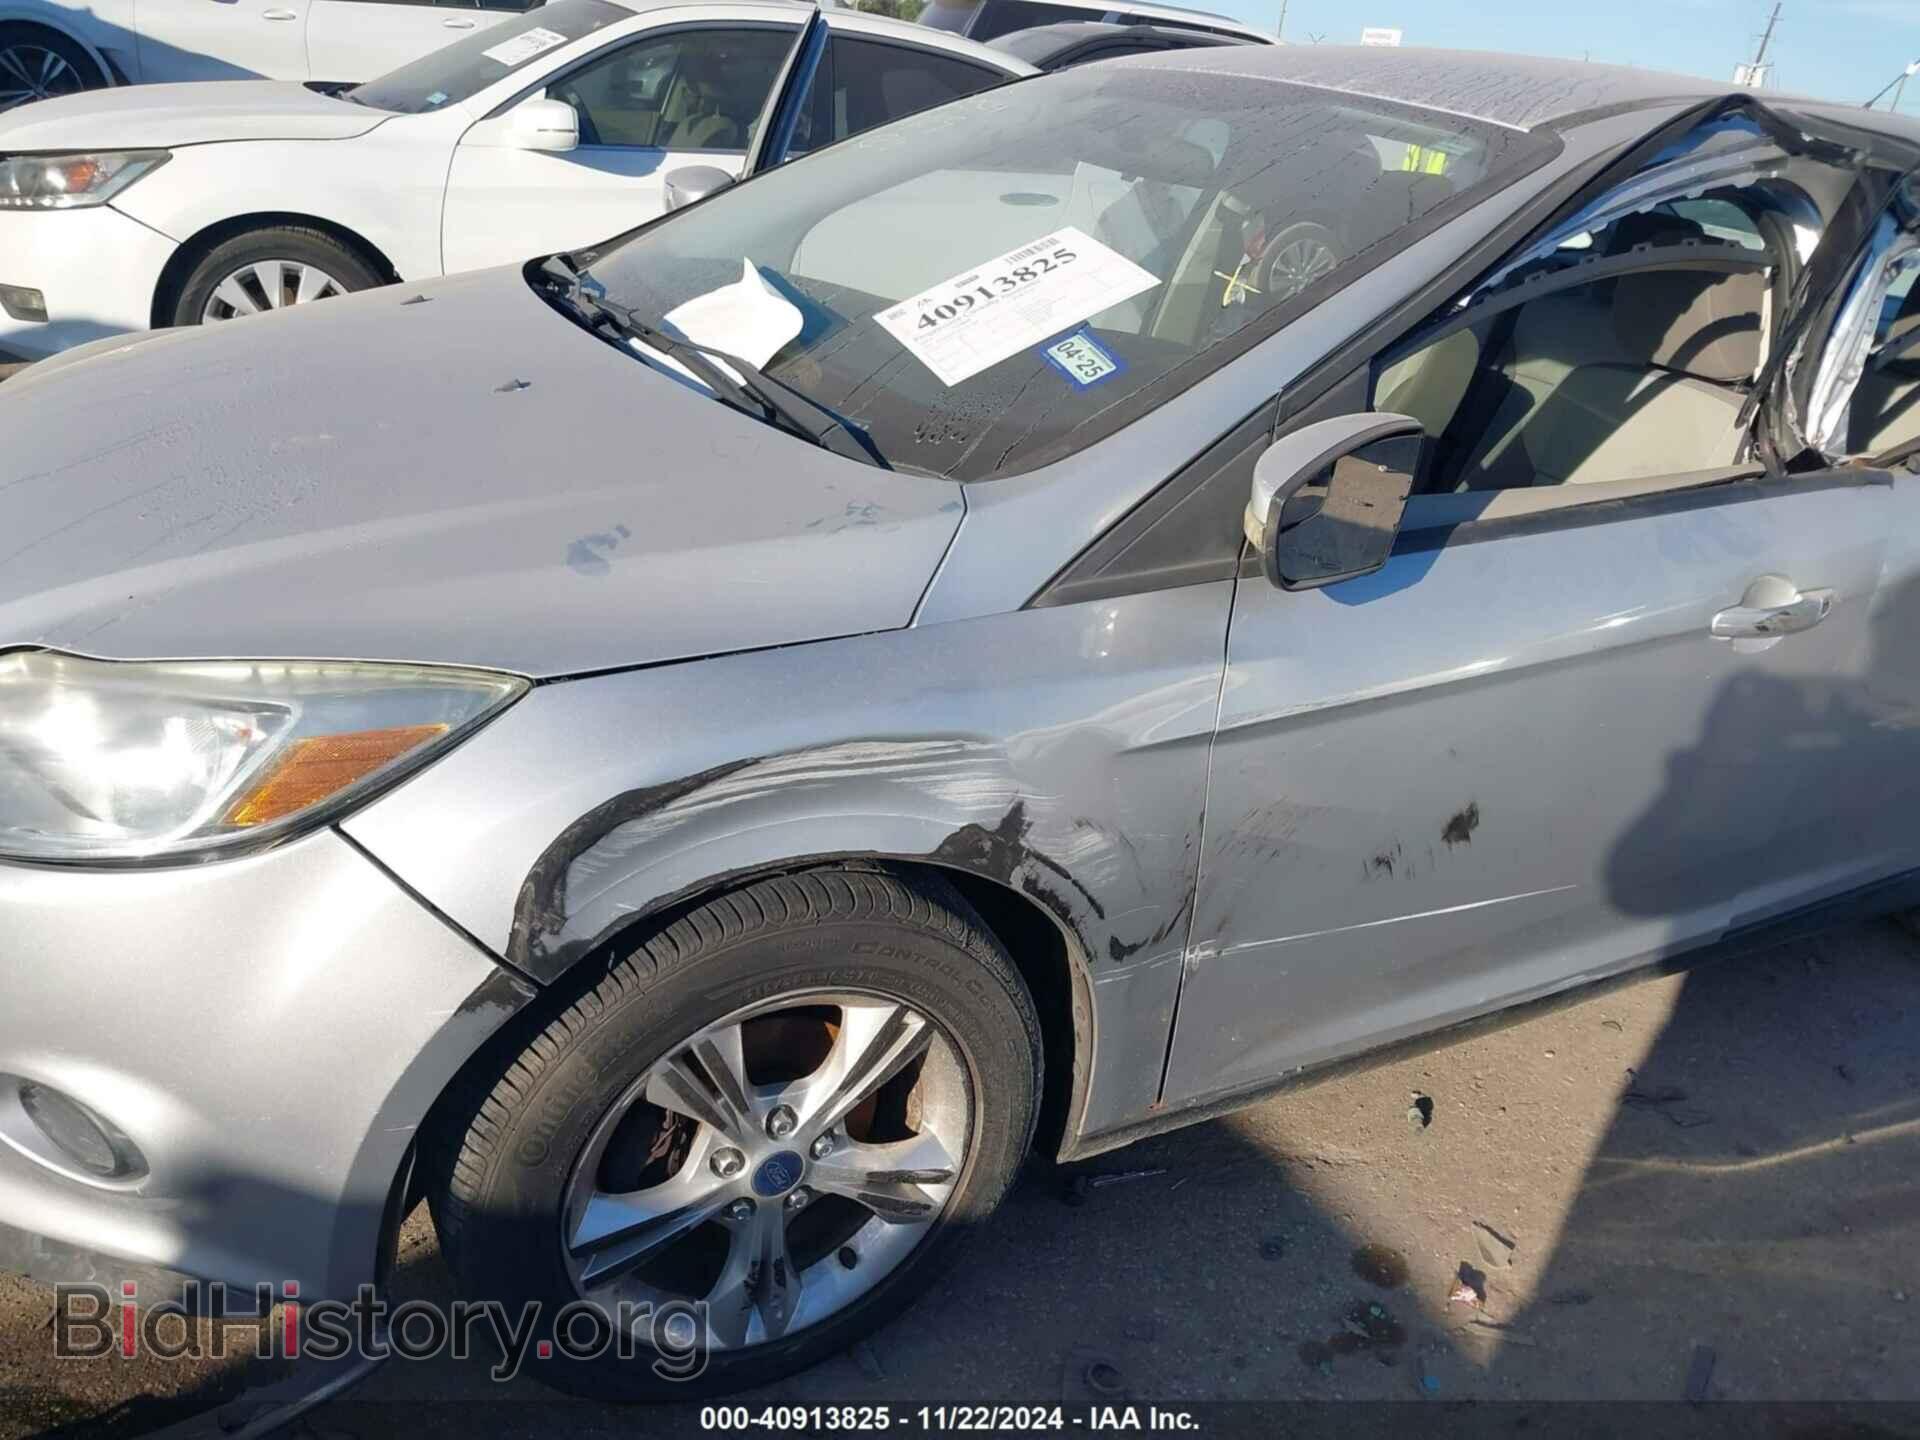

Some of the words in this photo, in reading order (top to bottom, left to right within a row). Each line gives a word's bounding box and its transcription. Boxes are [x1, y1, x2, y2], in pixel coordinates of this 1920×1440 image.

[916, 247, 1078, 330] 40913825
[1056, 341, 1084, 360] 04
[1075, 358, 1105, 378] 25
